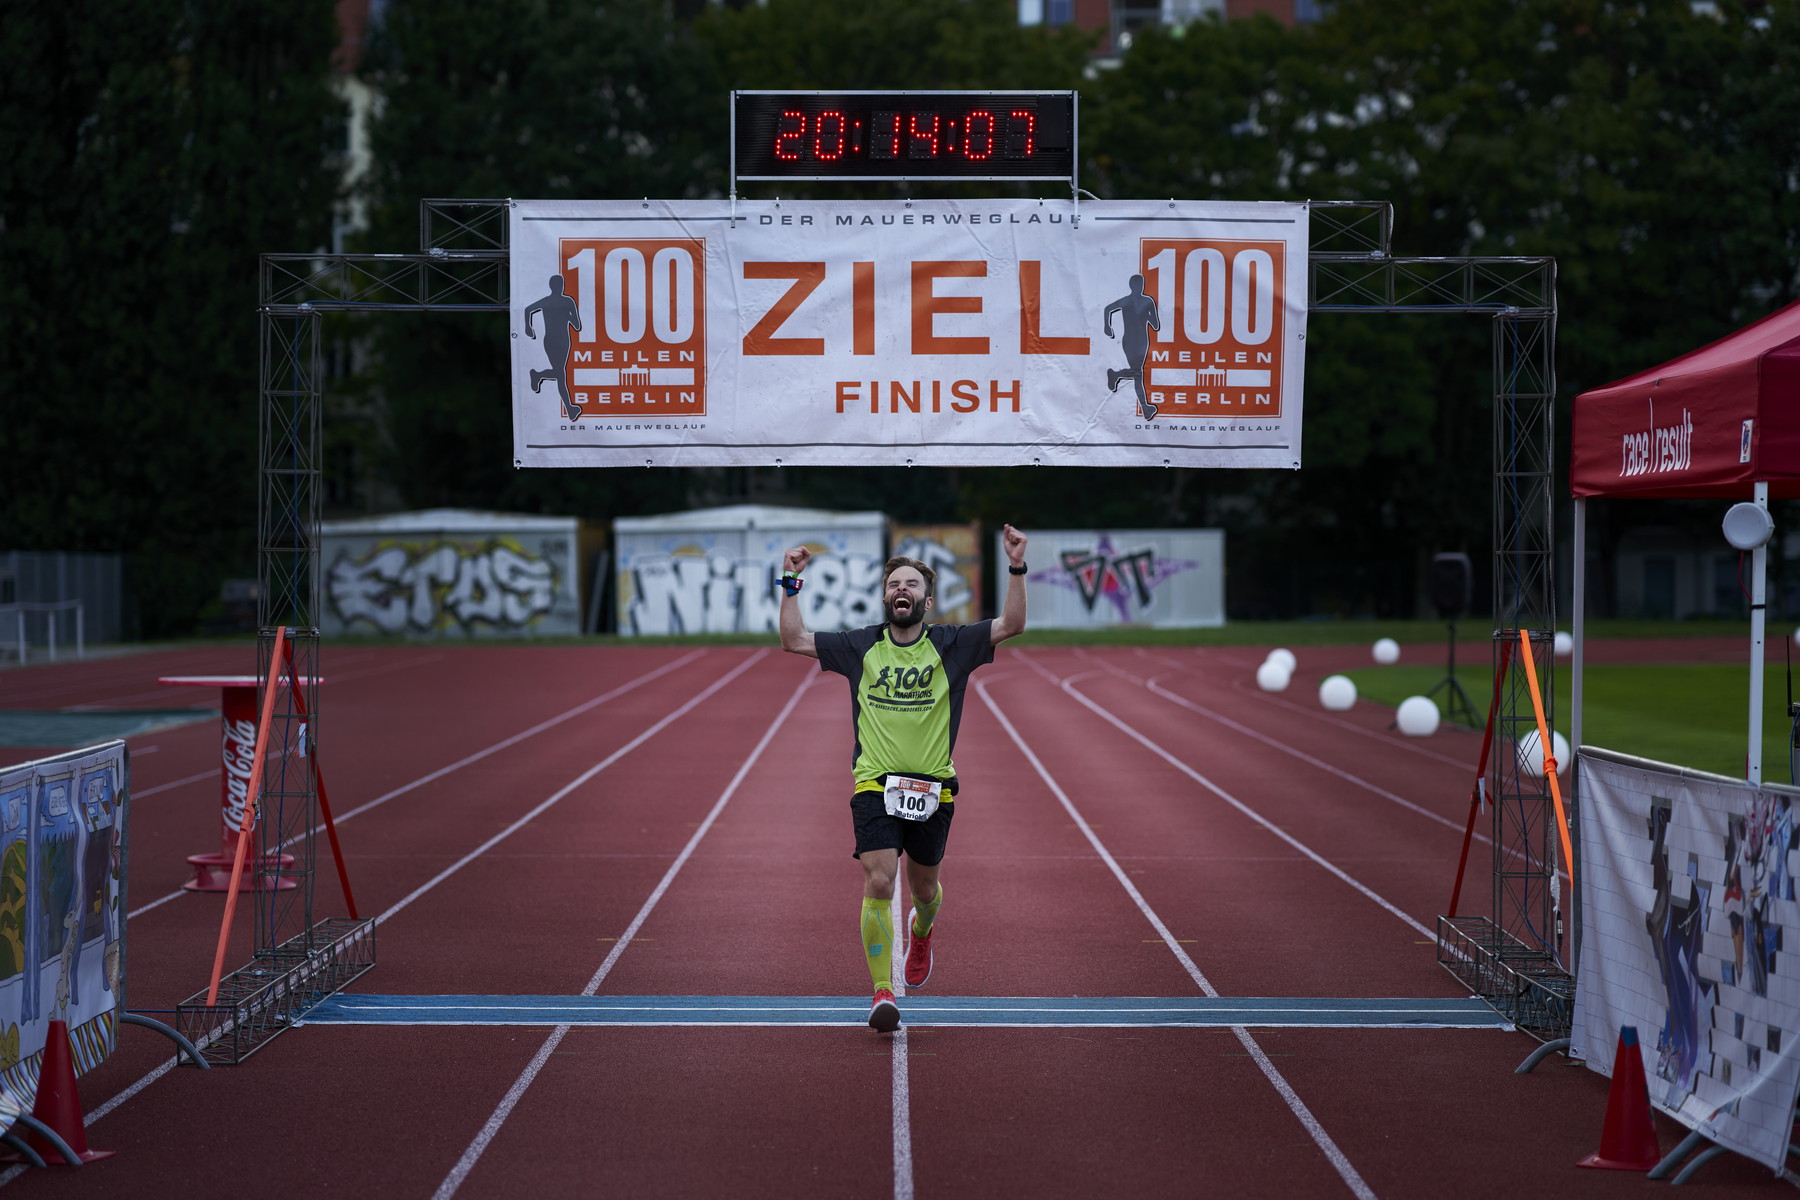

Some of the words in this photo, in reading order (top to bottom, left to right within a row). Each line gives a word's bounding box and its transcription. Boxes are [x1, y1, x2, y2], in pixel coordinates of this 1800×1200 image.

[775, 111, 1036, 160] 20:14:07
[760, 214, 813, 226] DER
[836, 214, 1081, 227] MAUERWEGLAUF
[567, 247, 695, 345] 100
[1147, 247, 1274, 346] 100
[742, 261, 1091, 356] ZIEL
[573, 350, 695, 362] MEILEN
[1151, 351, 1272, 363] MEILEN
[574, 392, 695, 404] BERLIN
[836, 380, 1020, 414] FINISH
[1151, 392, 1271, 405] BERLIN
[894, 664, 934, 689] 100
[893, 689, 933, 698] MARATHONS
[898, 794, 926, 812] 100
